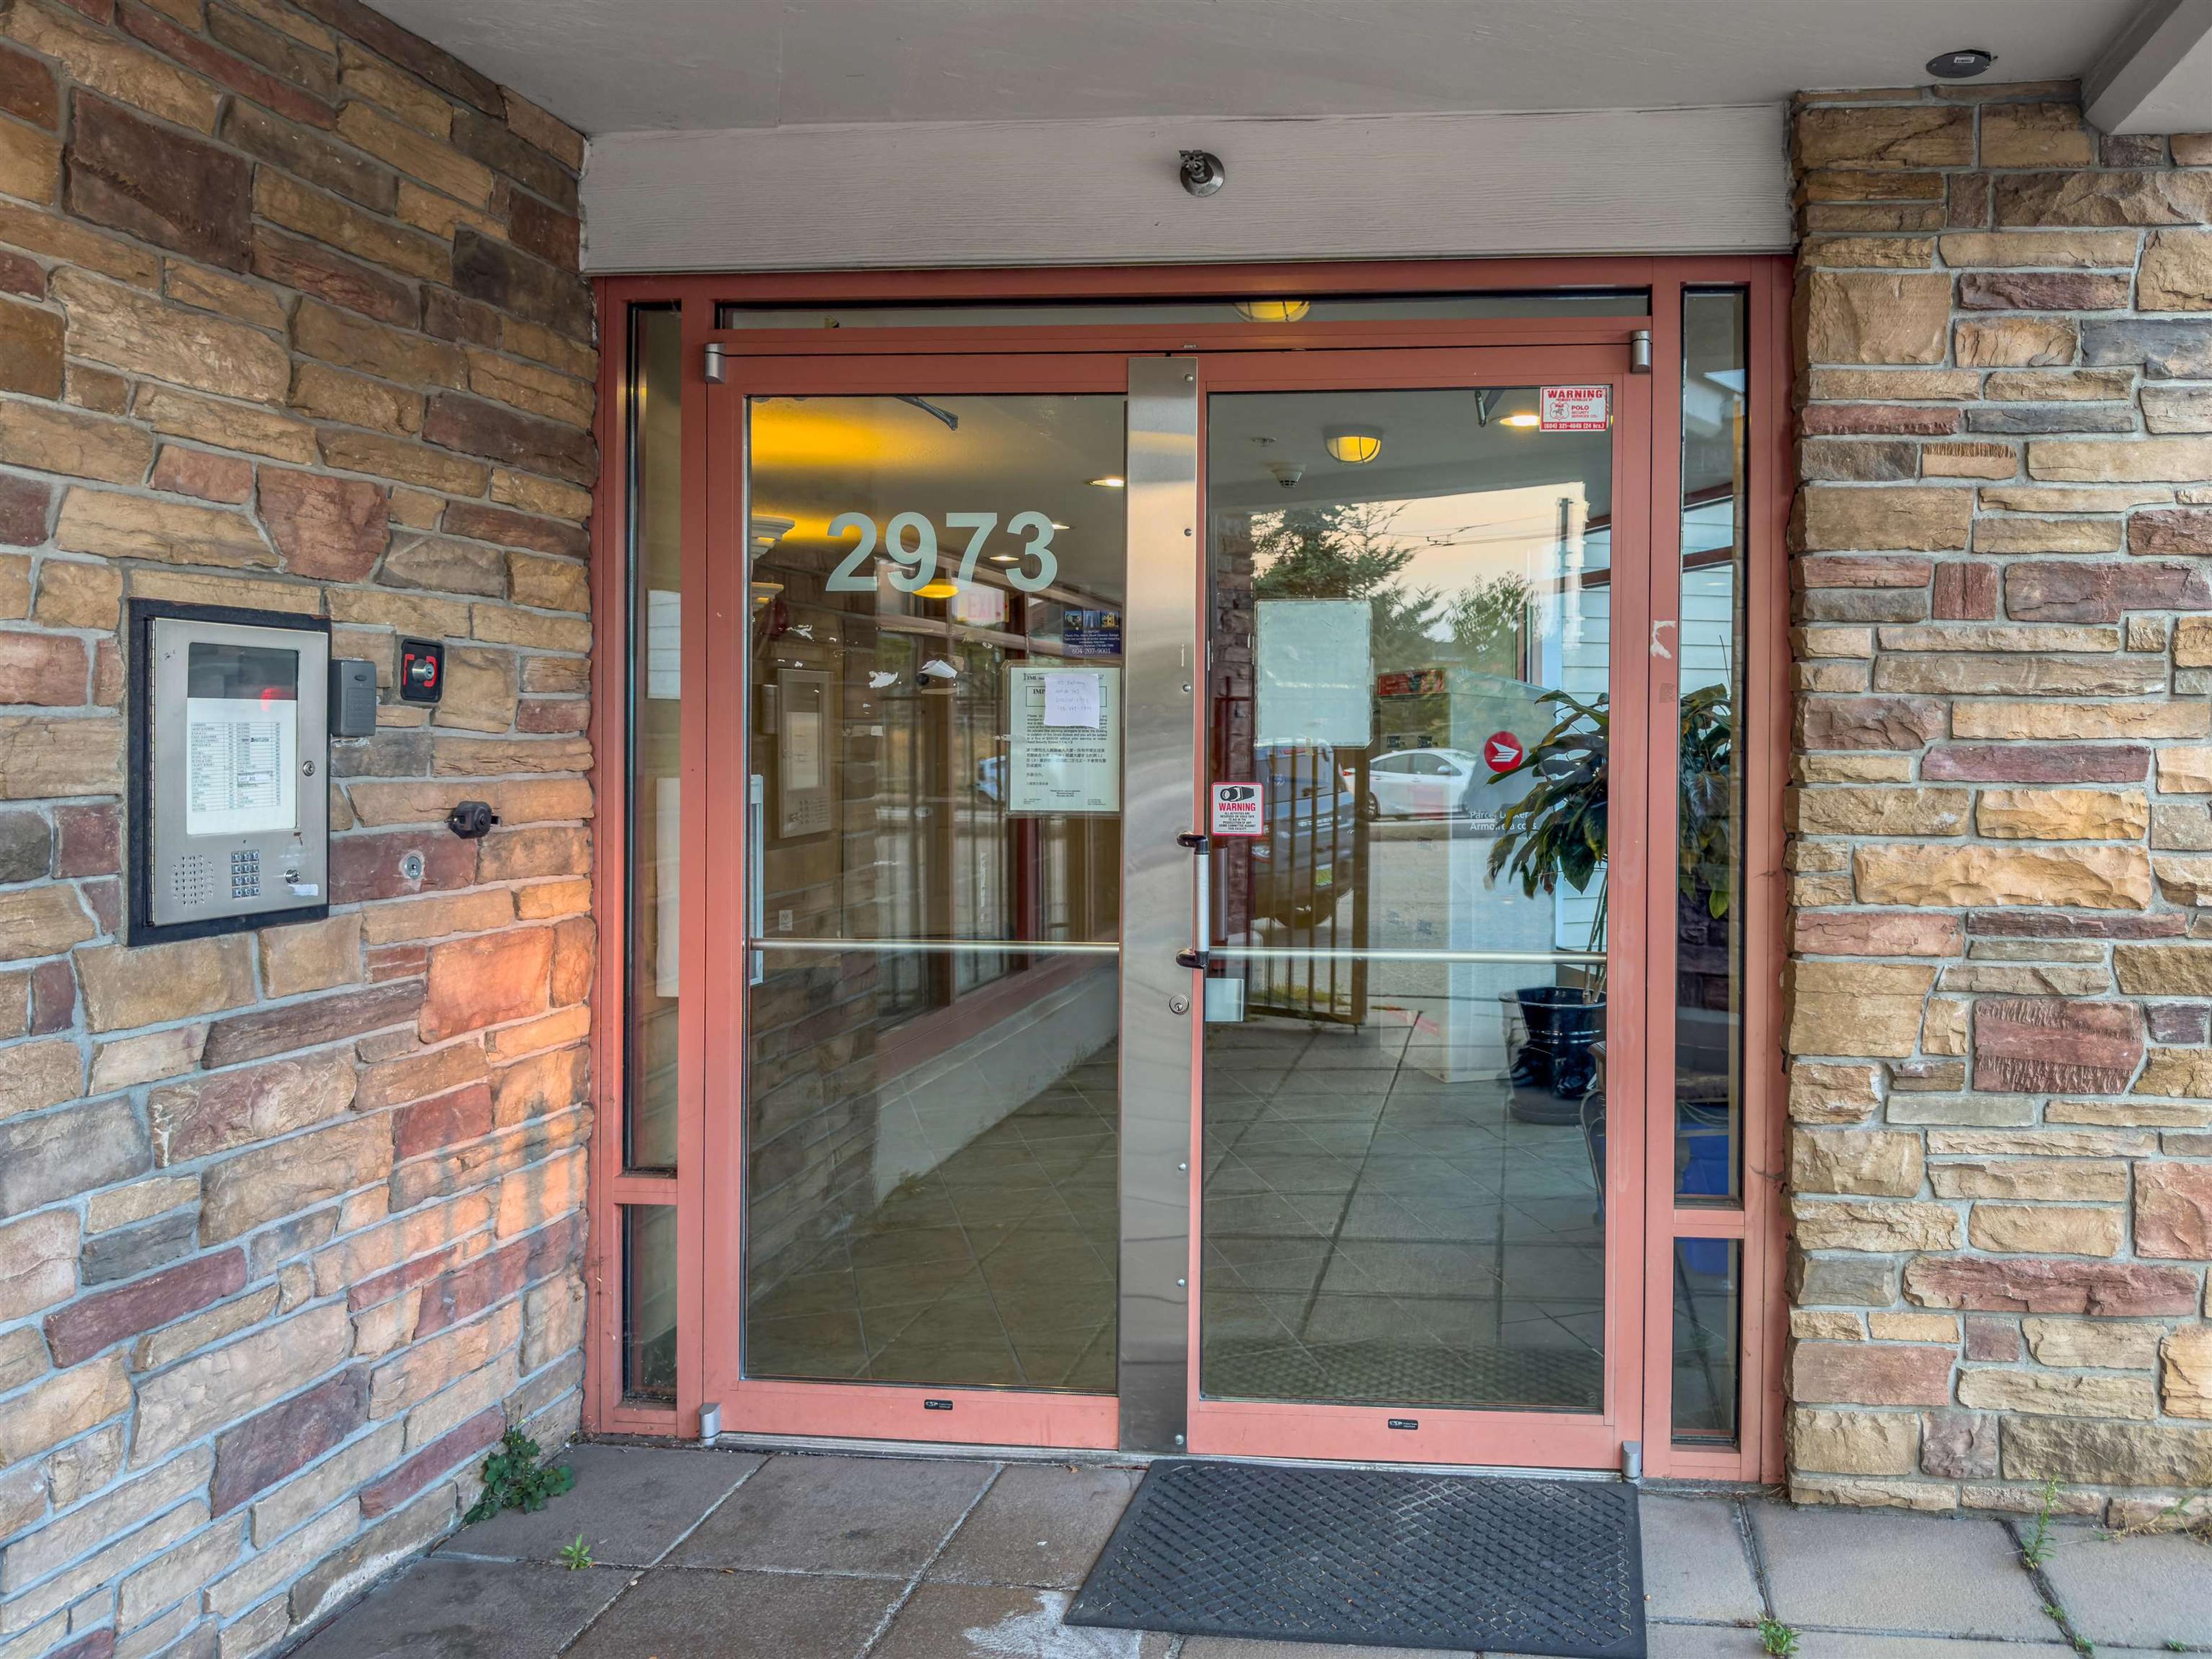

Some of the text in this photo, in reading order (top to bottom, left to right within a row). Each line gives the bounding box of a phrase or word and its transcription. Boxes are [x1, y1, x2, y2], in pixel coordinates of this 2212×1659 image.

[1547, 390, 1603, 398] WARNING
[825, 511, 1058, 592] 2973
[1219, 802, 1256, 811] WARNING
